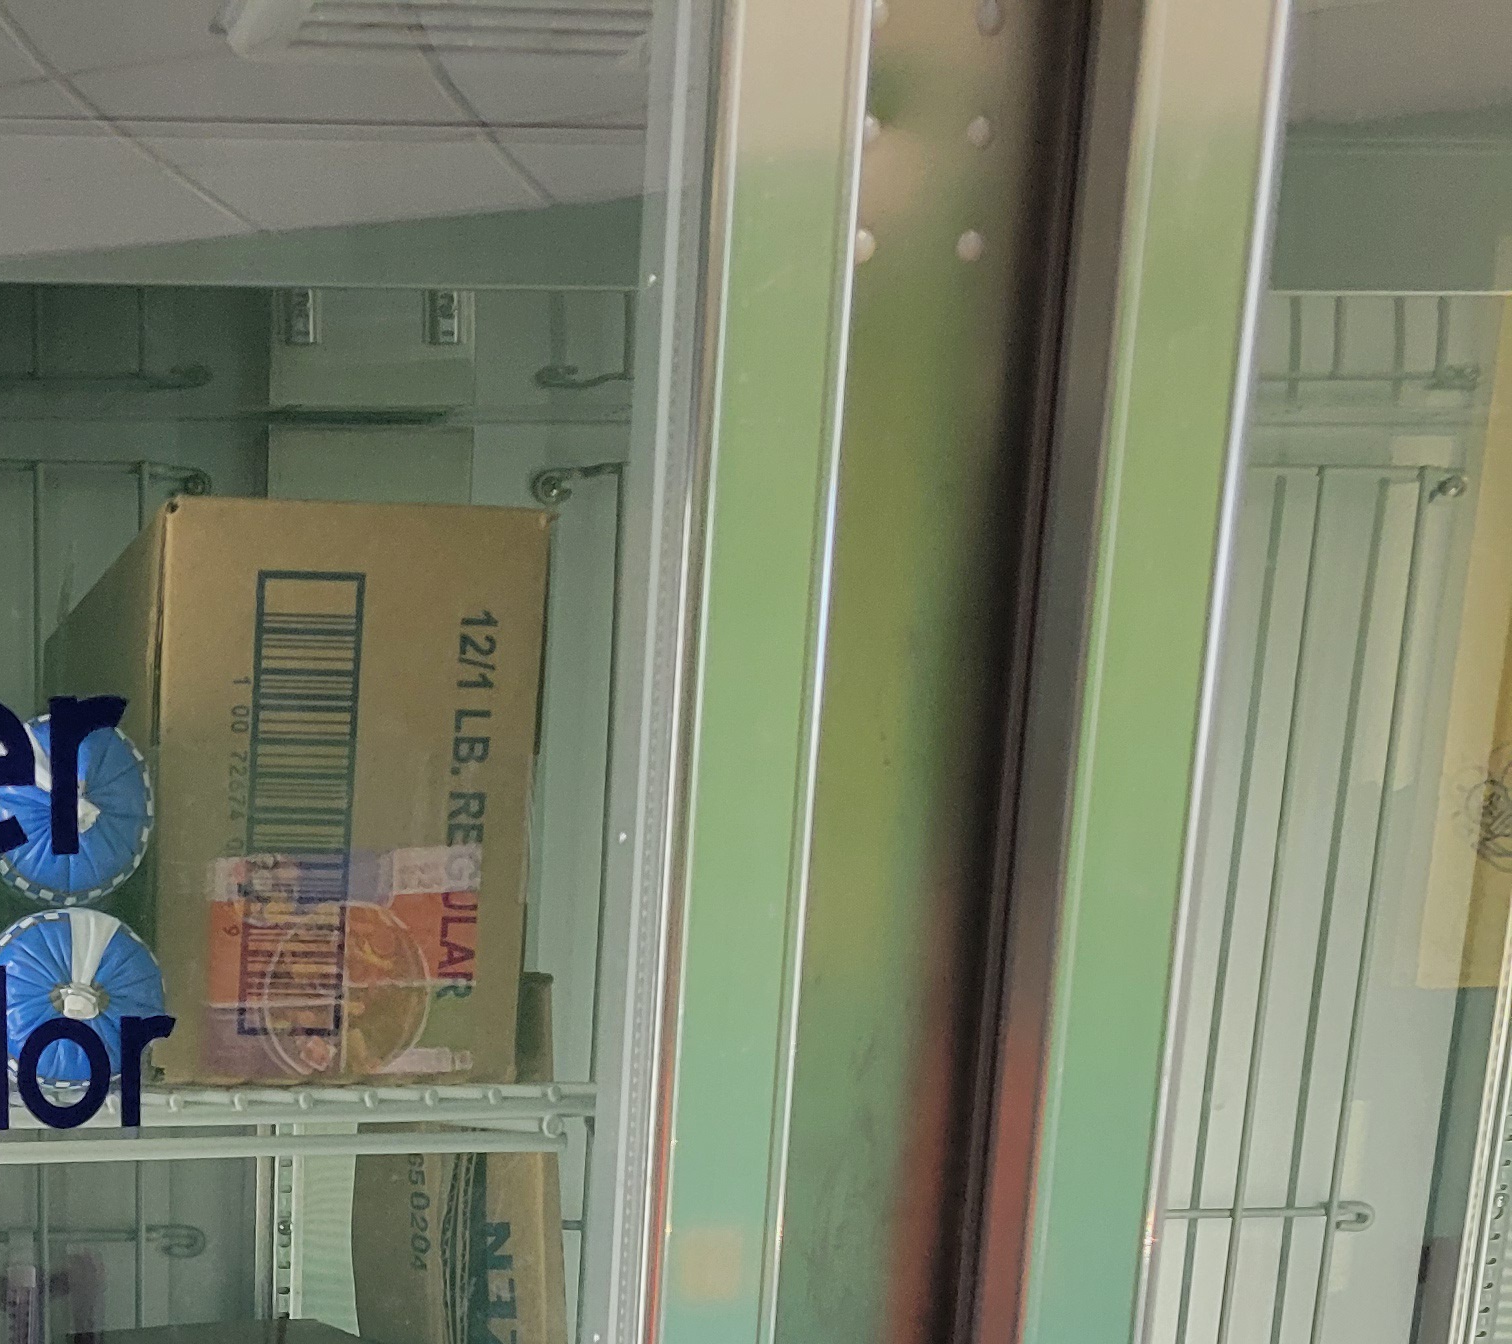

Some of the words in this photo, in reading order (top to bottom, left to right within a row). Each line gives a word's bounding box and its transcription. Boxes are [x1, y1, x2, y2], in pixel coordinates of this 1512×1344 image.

[457, 609, 499, 691] 12/1
[450, 708, 492, 777] LB.
[436, 790, 487, 1000] REGULAR
